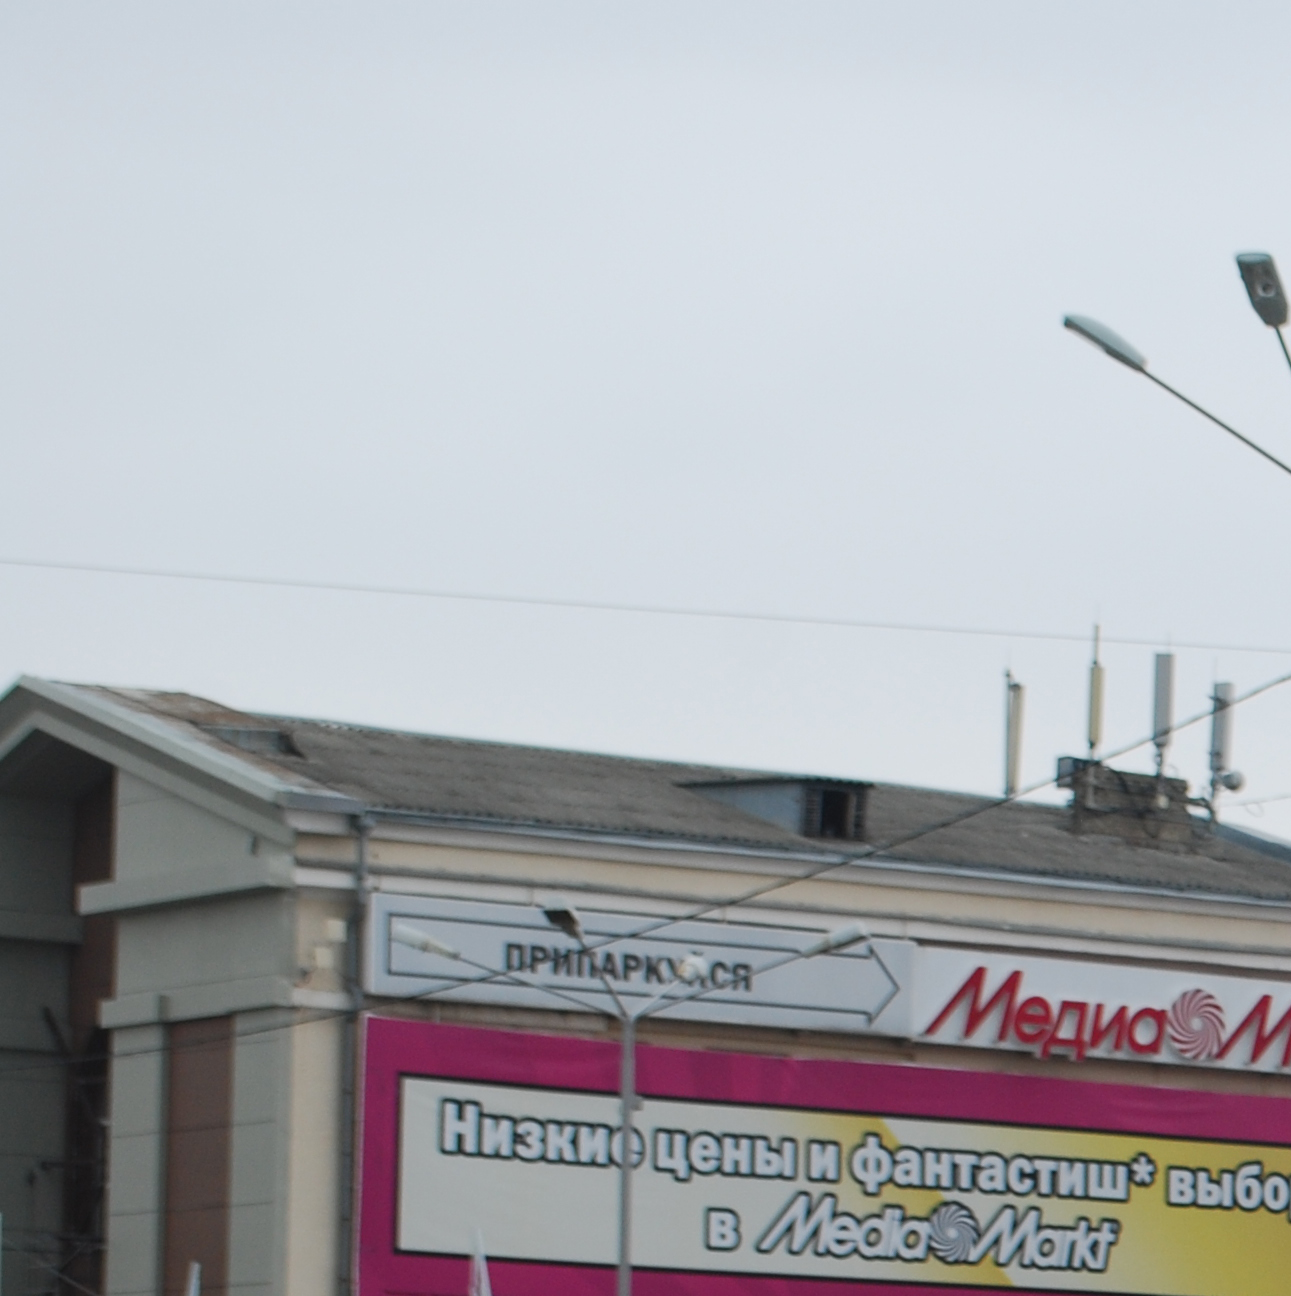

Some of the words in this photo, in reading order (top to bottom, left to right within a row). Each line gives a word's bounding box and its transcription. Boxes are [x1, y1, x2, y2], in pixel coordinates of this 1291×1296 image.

[505, 943, 754, 991] ПРИПАРКУСЯ
[439, 1098, 645, 1168] Низкие
[653, 1126, 798, 1181] цены
[806, 1139, 842, 1182] и
[705, 1206, 742, 1251] в
